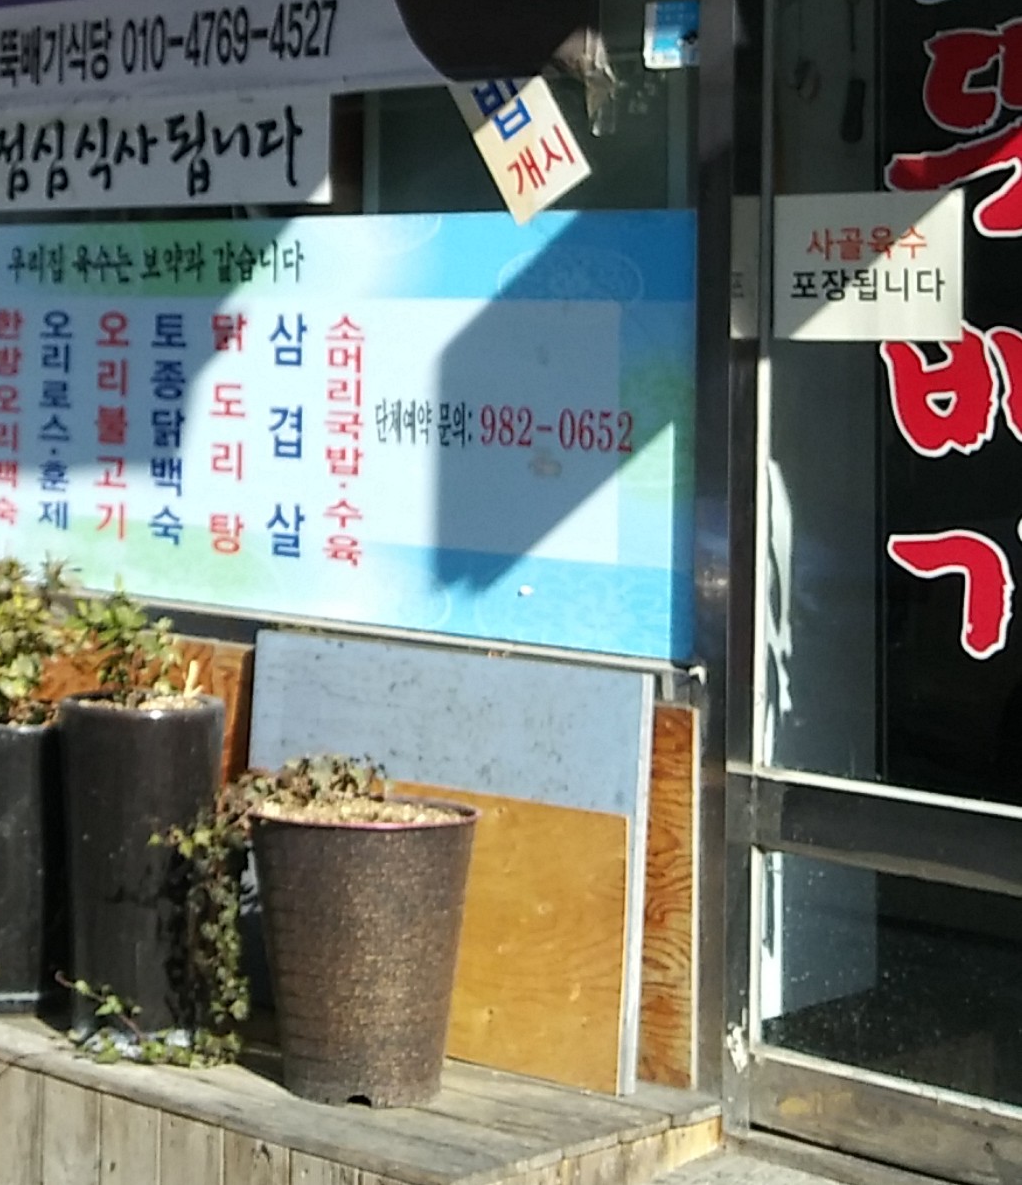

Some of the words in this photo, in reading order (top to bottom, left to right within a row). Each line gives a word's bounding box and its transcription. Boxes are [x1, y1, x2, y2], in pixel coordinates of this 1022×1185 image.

[121, 0, 338, 75] 010-4769-4527
[506, 124, 576, 195] 개시
[7, 244, 64, 283] 우리집
[73, 244, 132, 284] 육수는
[141, 240, 204, 283] 보약과
[213, 240, 304, 283] 같습니다
[806, 225, 928, 261] 사골육수
[790, 267, 946, 302] 포장됩니다
[95, 311, 130, 540] 오리불고기
[148, 312, 187, 545] 토종닭백숙
[375, 398, 433, 445] 단체예약
[480, 404, 634, 453] 982-0652
